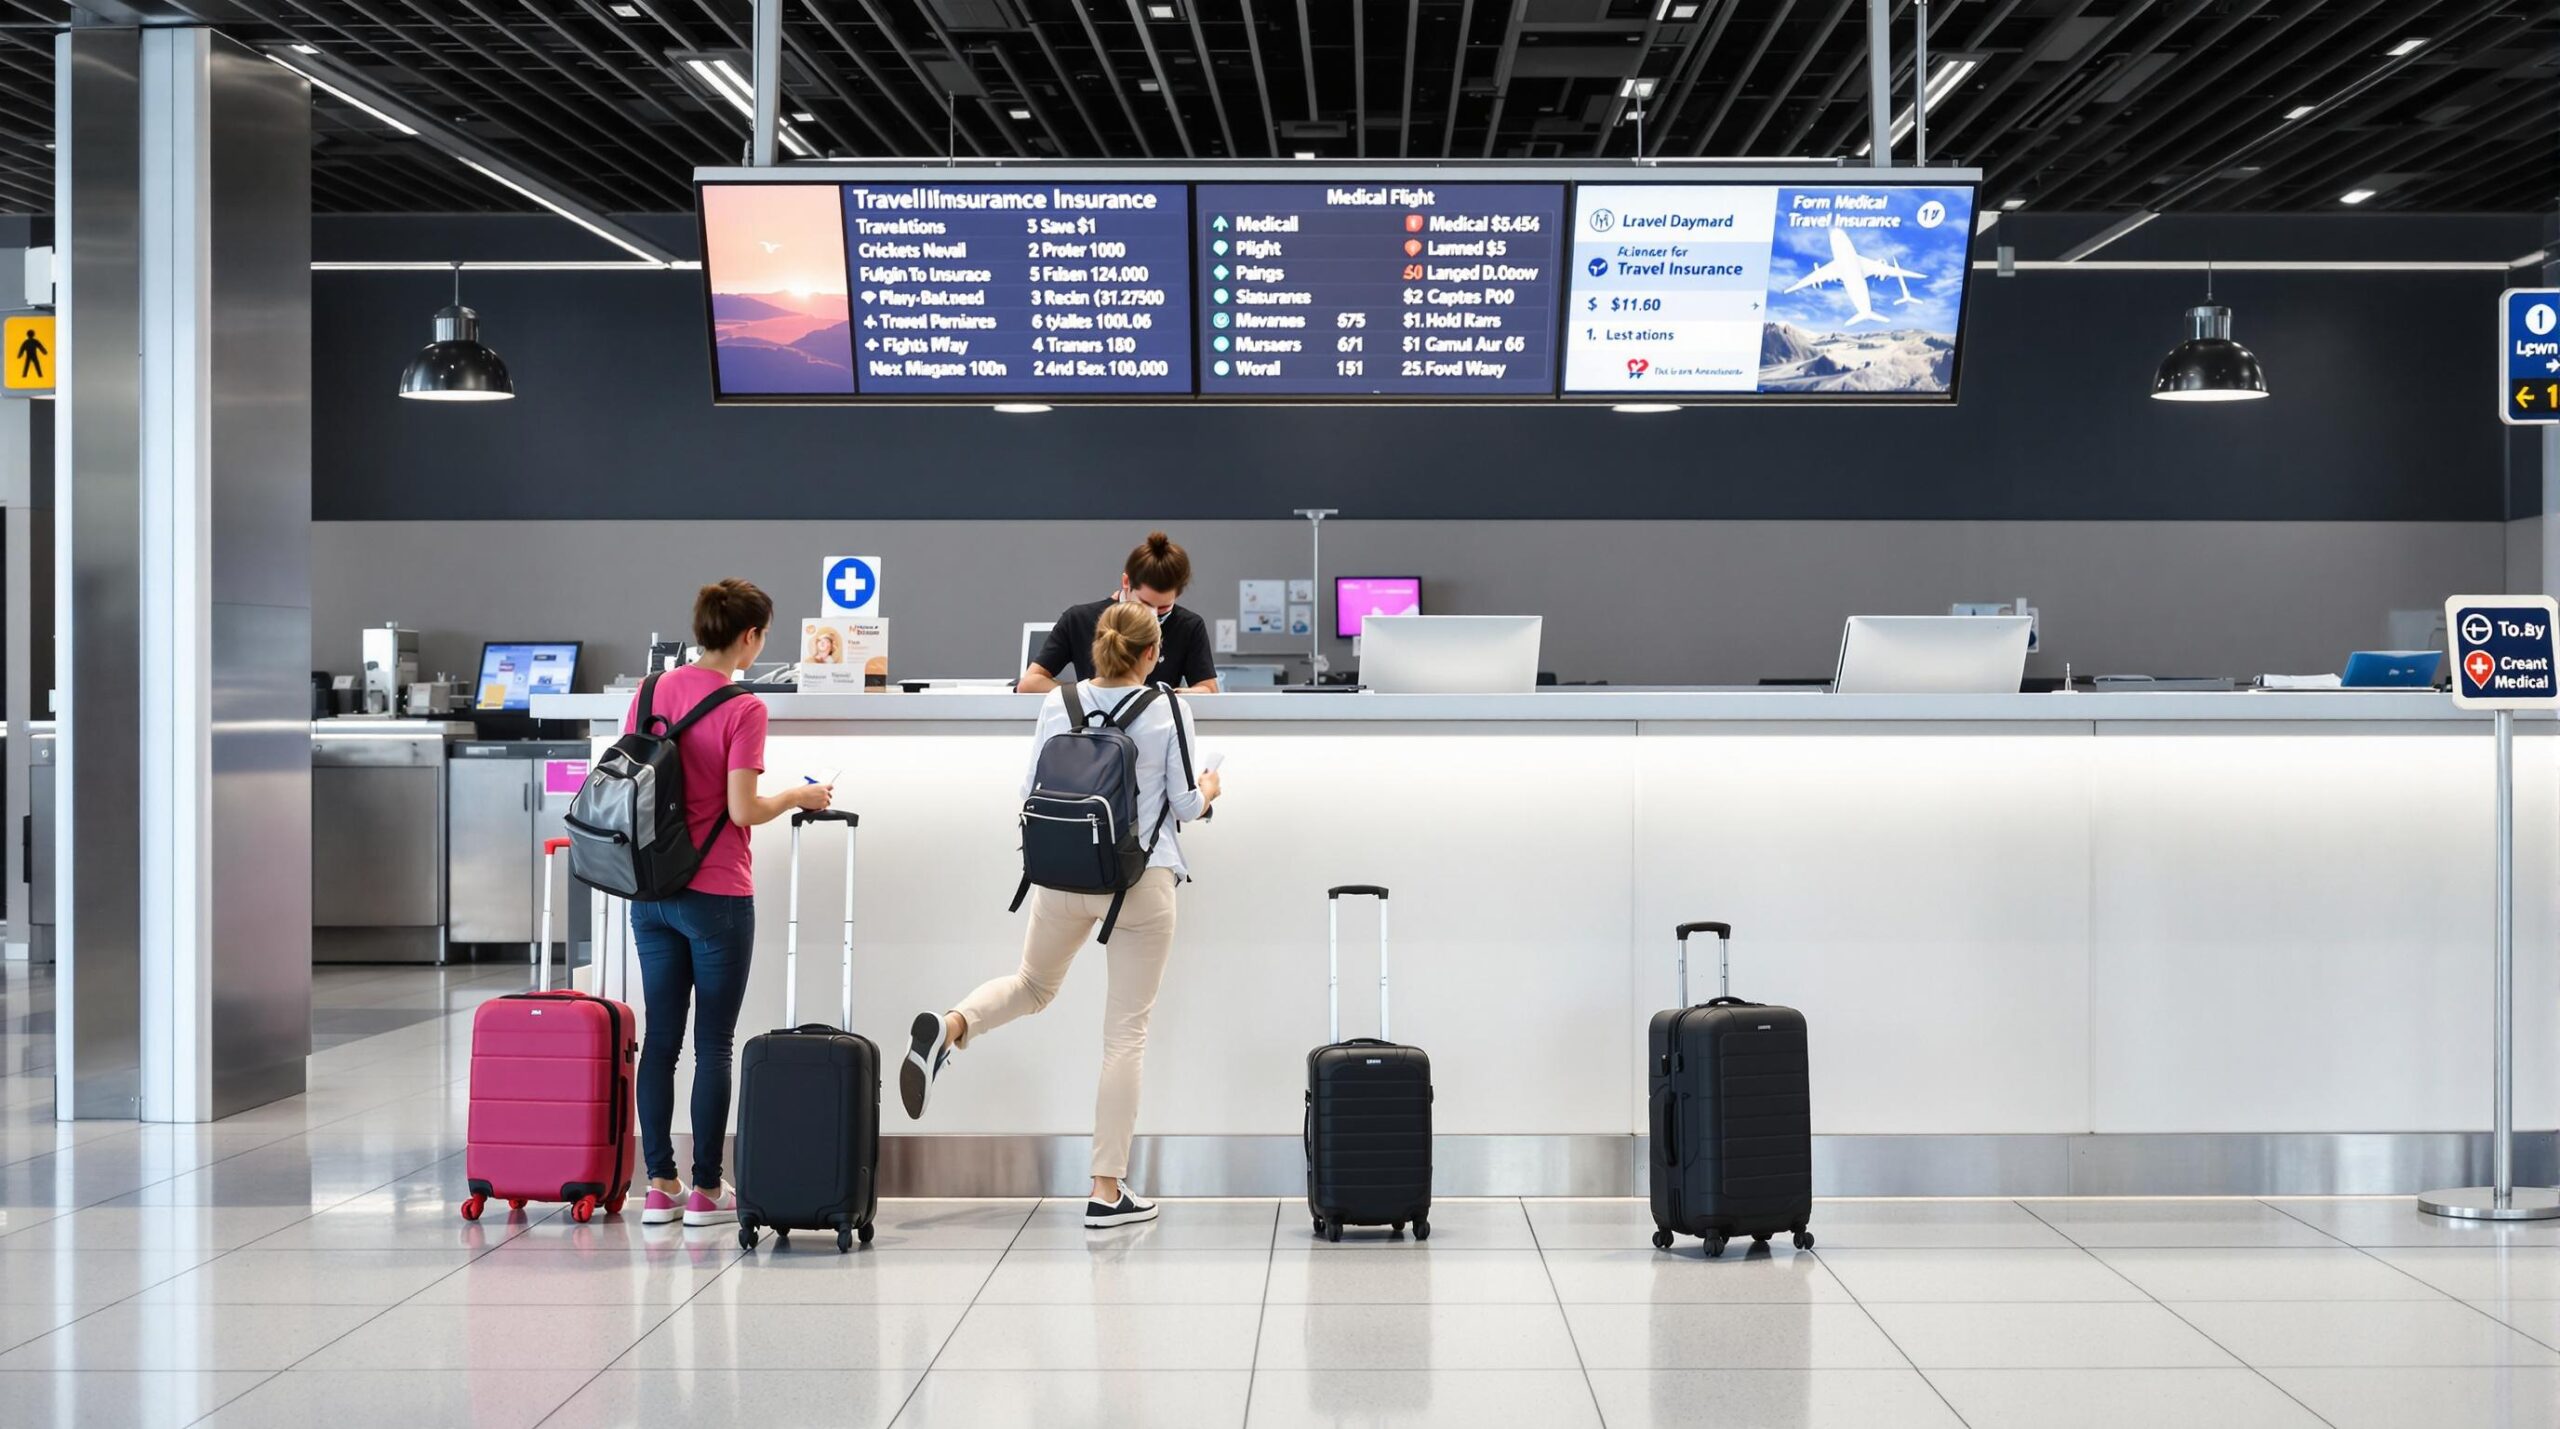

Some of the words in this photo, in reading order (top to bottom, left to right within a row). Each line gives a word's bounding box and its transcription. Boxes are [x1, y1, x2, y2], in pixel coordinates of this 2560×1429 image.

[1054, 188, 1157, 209] Insurance
[1327, 188, 1387, 205] Medical
[1390, 188, 1435, 208] Flight
[1793, 195, 1831, 210] Form
[1834, 195, 1888, 210] Medical
[1040, 218, 1076, 234] Save
[1077, 216, 1096, 235] $1
[1429, 215, 1488, 232] Medical
[1622, 214, 1667, 228] Lravel
[1670, 214, 1734, 231] Daymard
[1789, 213, 1832, 228] Travel
[1834, 213, 1901, 228] Insurance
[1028, 242, 1040, 258] 2
[1089, 242, 1126, 258] 1000
[1486, 239, 1507, 257] $5
[908, 267, 927, 282] To
[1029, 266, 1040, 282] 5
[1618, 262, 1665, 276] Travel
[1669, 262, 1743, 276] Insurance
[1031, 290, 1041, 305] 3
[1610, 297, 1661, 312] $11.60
[1031, 314, 1043, 329] 6
[2537, 309, 2543, 329] 1
[1032, 337, 1044, 353] 4
[2500, 656, 2548, 670] Creant
[2495, 674, 2549, 689] Medical
